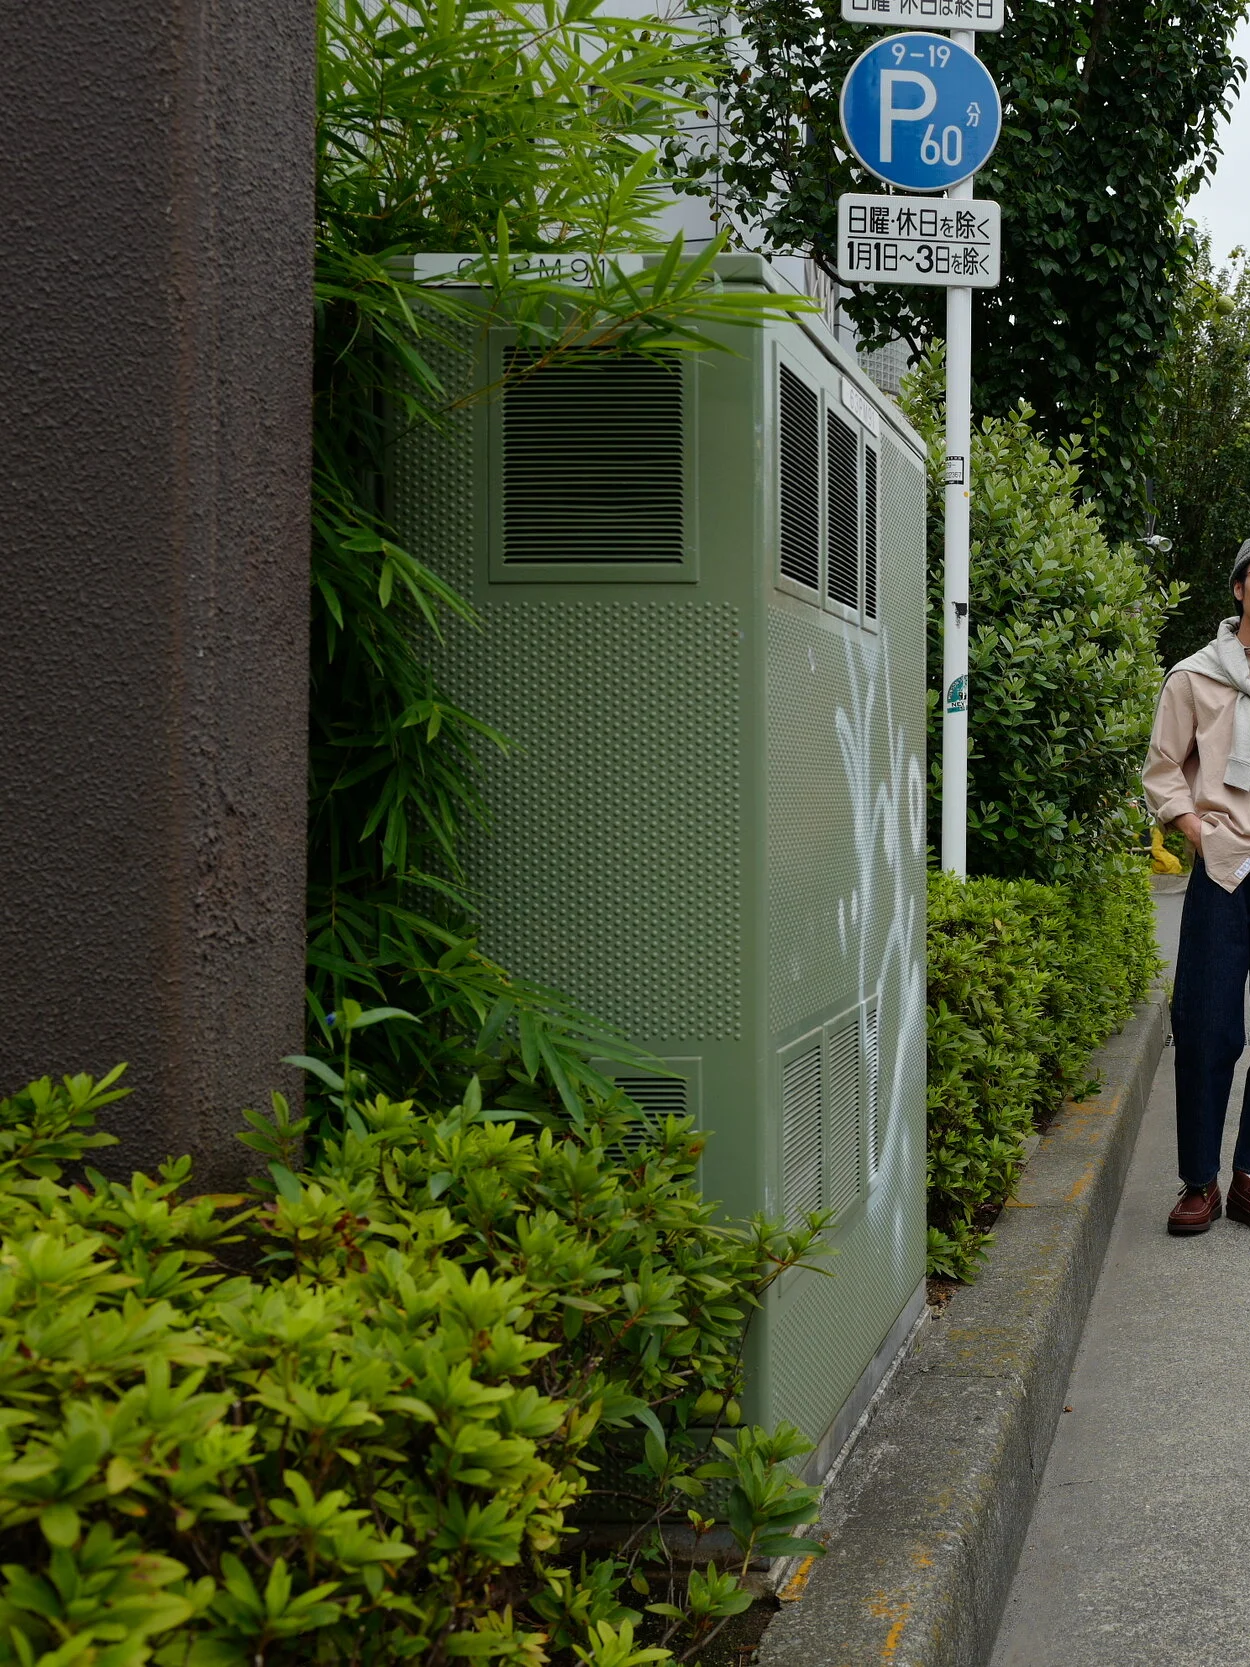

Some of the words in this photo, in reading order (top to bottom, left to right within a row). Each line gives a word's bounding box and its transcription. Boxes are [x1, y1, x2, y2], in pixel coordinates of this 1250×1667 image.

[852, 0, 993, 19] 休日は終日
[891, 43, 951, 68] 9-19
[879, 69, 937, 164] P
